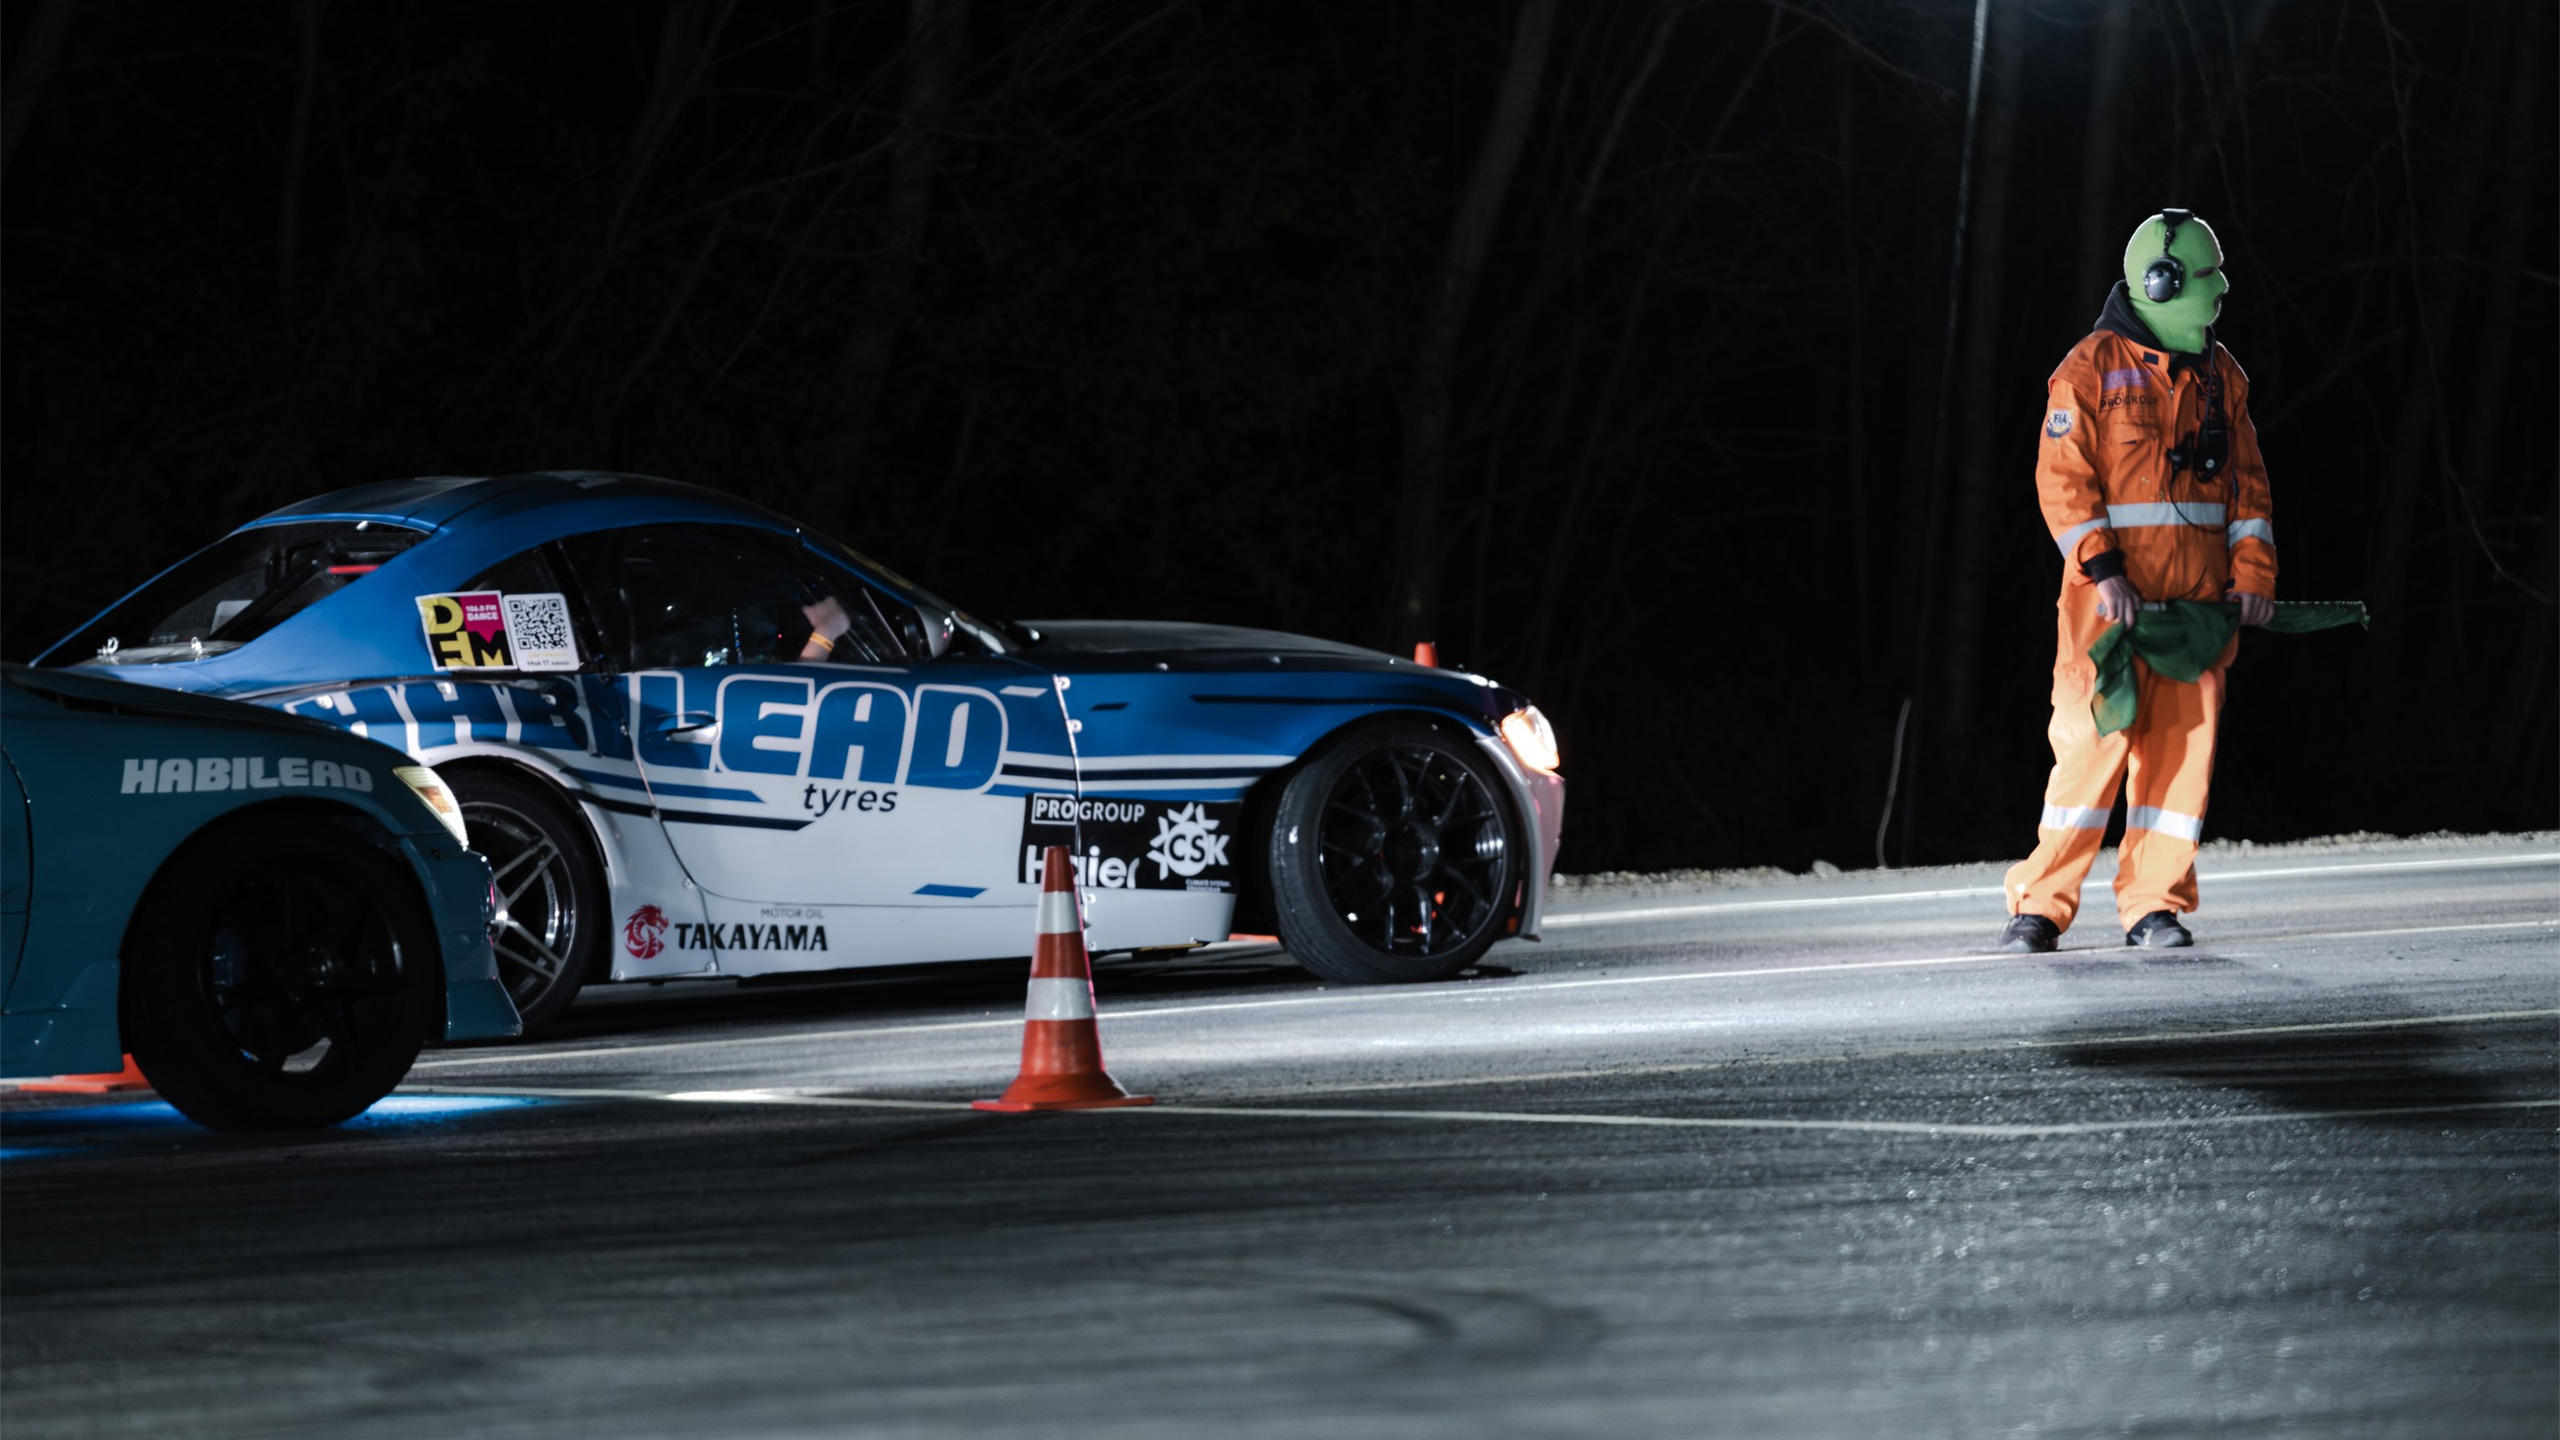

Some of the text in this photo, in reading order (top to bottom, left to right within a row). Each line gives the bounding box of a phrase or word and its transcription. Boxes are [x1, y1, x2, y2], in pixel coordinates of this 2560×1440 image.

[2053, 413, 2067, 424] FIA
[466, 611, 499, 621] DANCE
[121, 757, 373, 794] HABILEAD
[803, 783, 898, 817] tyres
[760, 908, 825, 919] MOTOR OIL
[674, 923, 828, 951] TAKAYAMA
